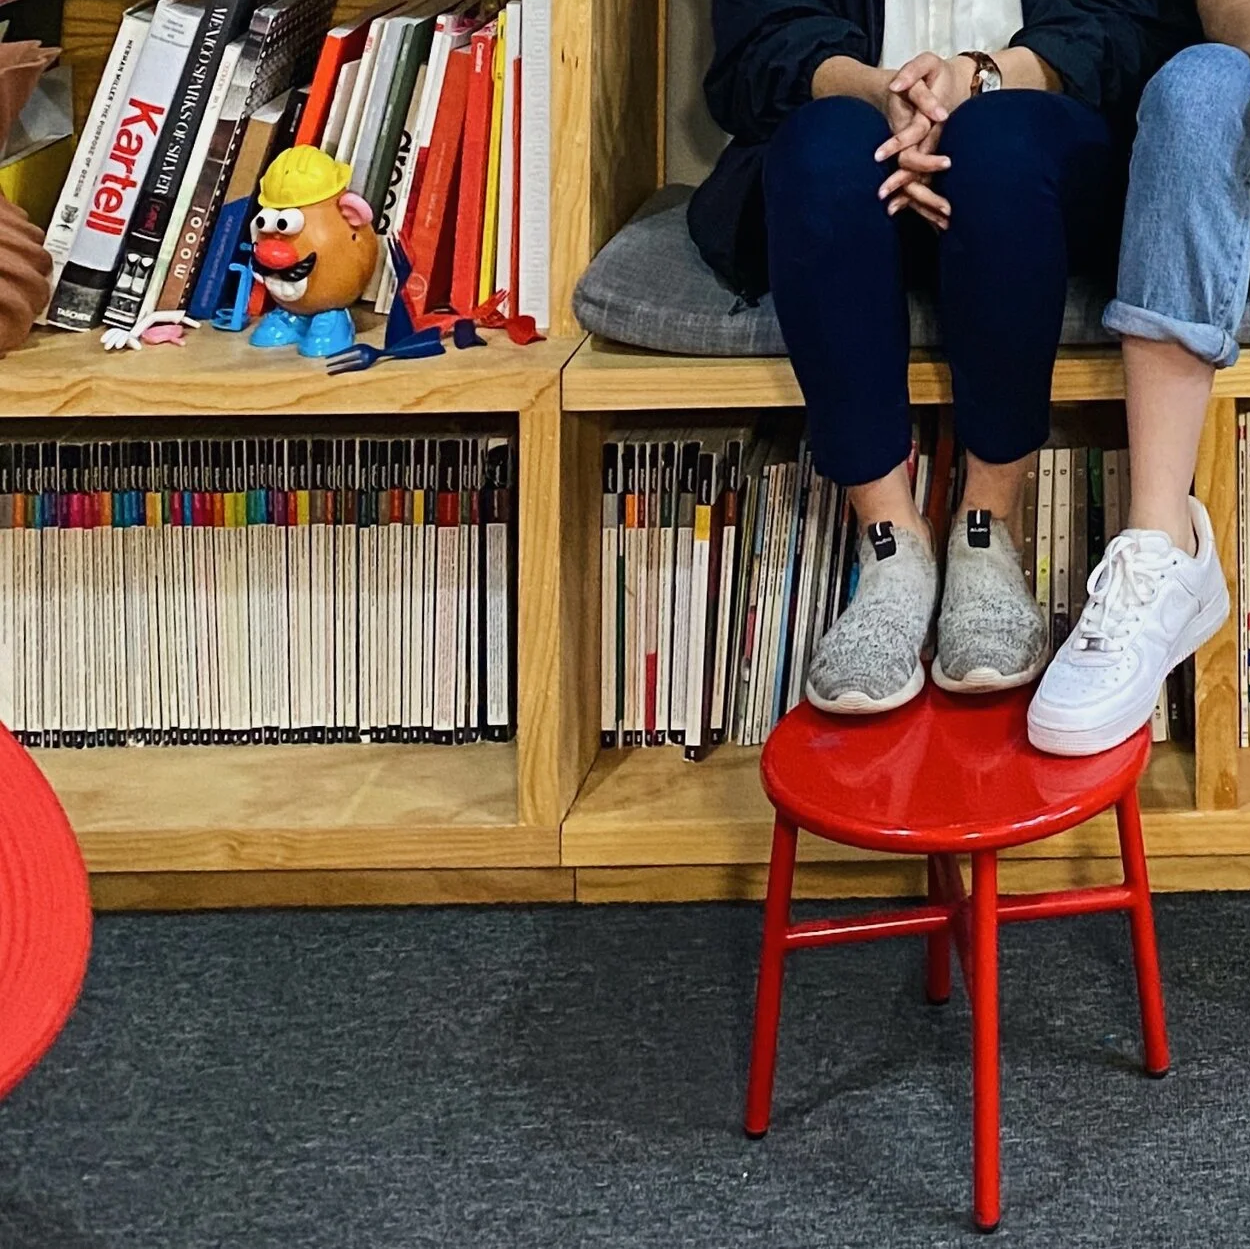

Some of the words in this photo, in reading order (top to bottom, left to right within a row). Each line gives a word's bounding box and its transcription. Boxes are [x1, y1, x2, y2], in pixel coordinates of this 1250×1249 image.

[198, 6, 228, 64] MEXICO
[118, 39, 133, 72] HERMAN
[107, 72, 122, 101] MILLER
[178, 64, 208, 120] SPARKS
[101, 103, 112, 118] THE
[86, 120, 107, 156] PURPOSE
[172, 121, 189, 143] OF
[83, 157, 92, 167] OF
[85, 97, 165, 236] Kartell
[154, 143, 182, 195] SILVER
[73, 169, 89, 198] DESIGN
